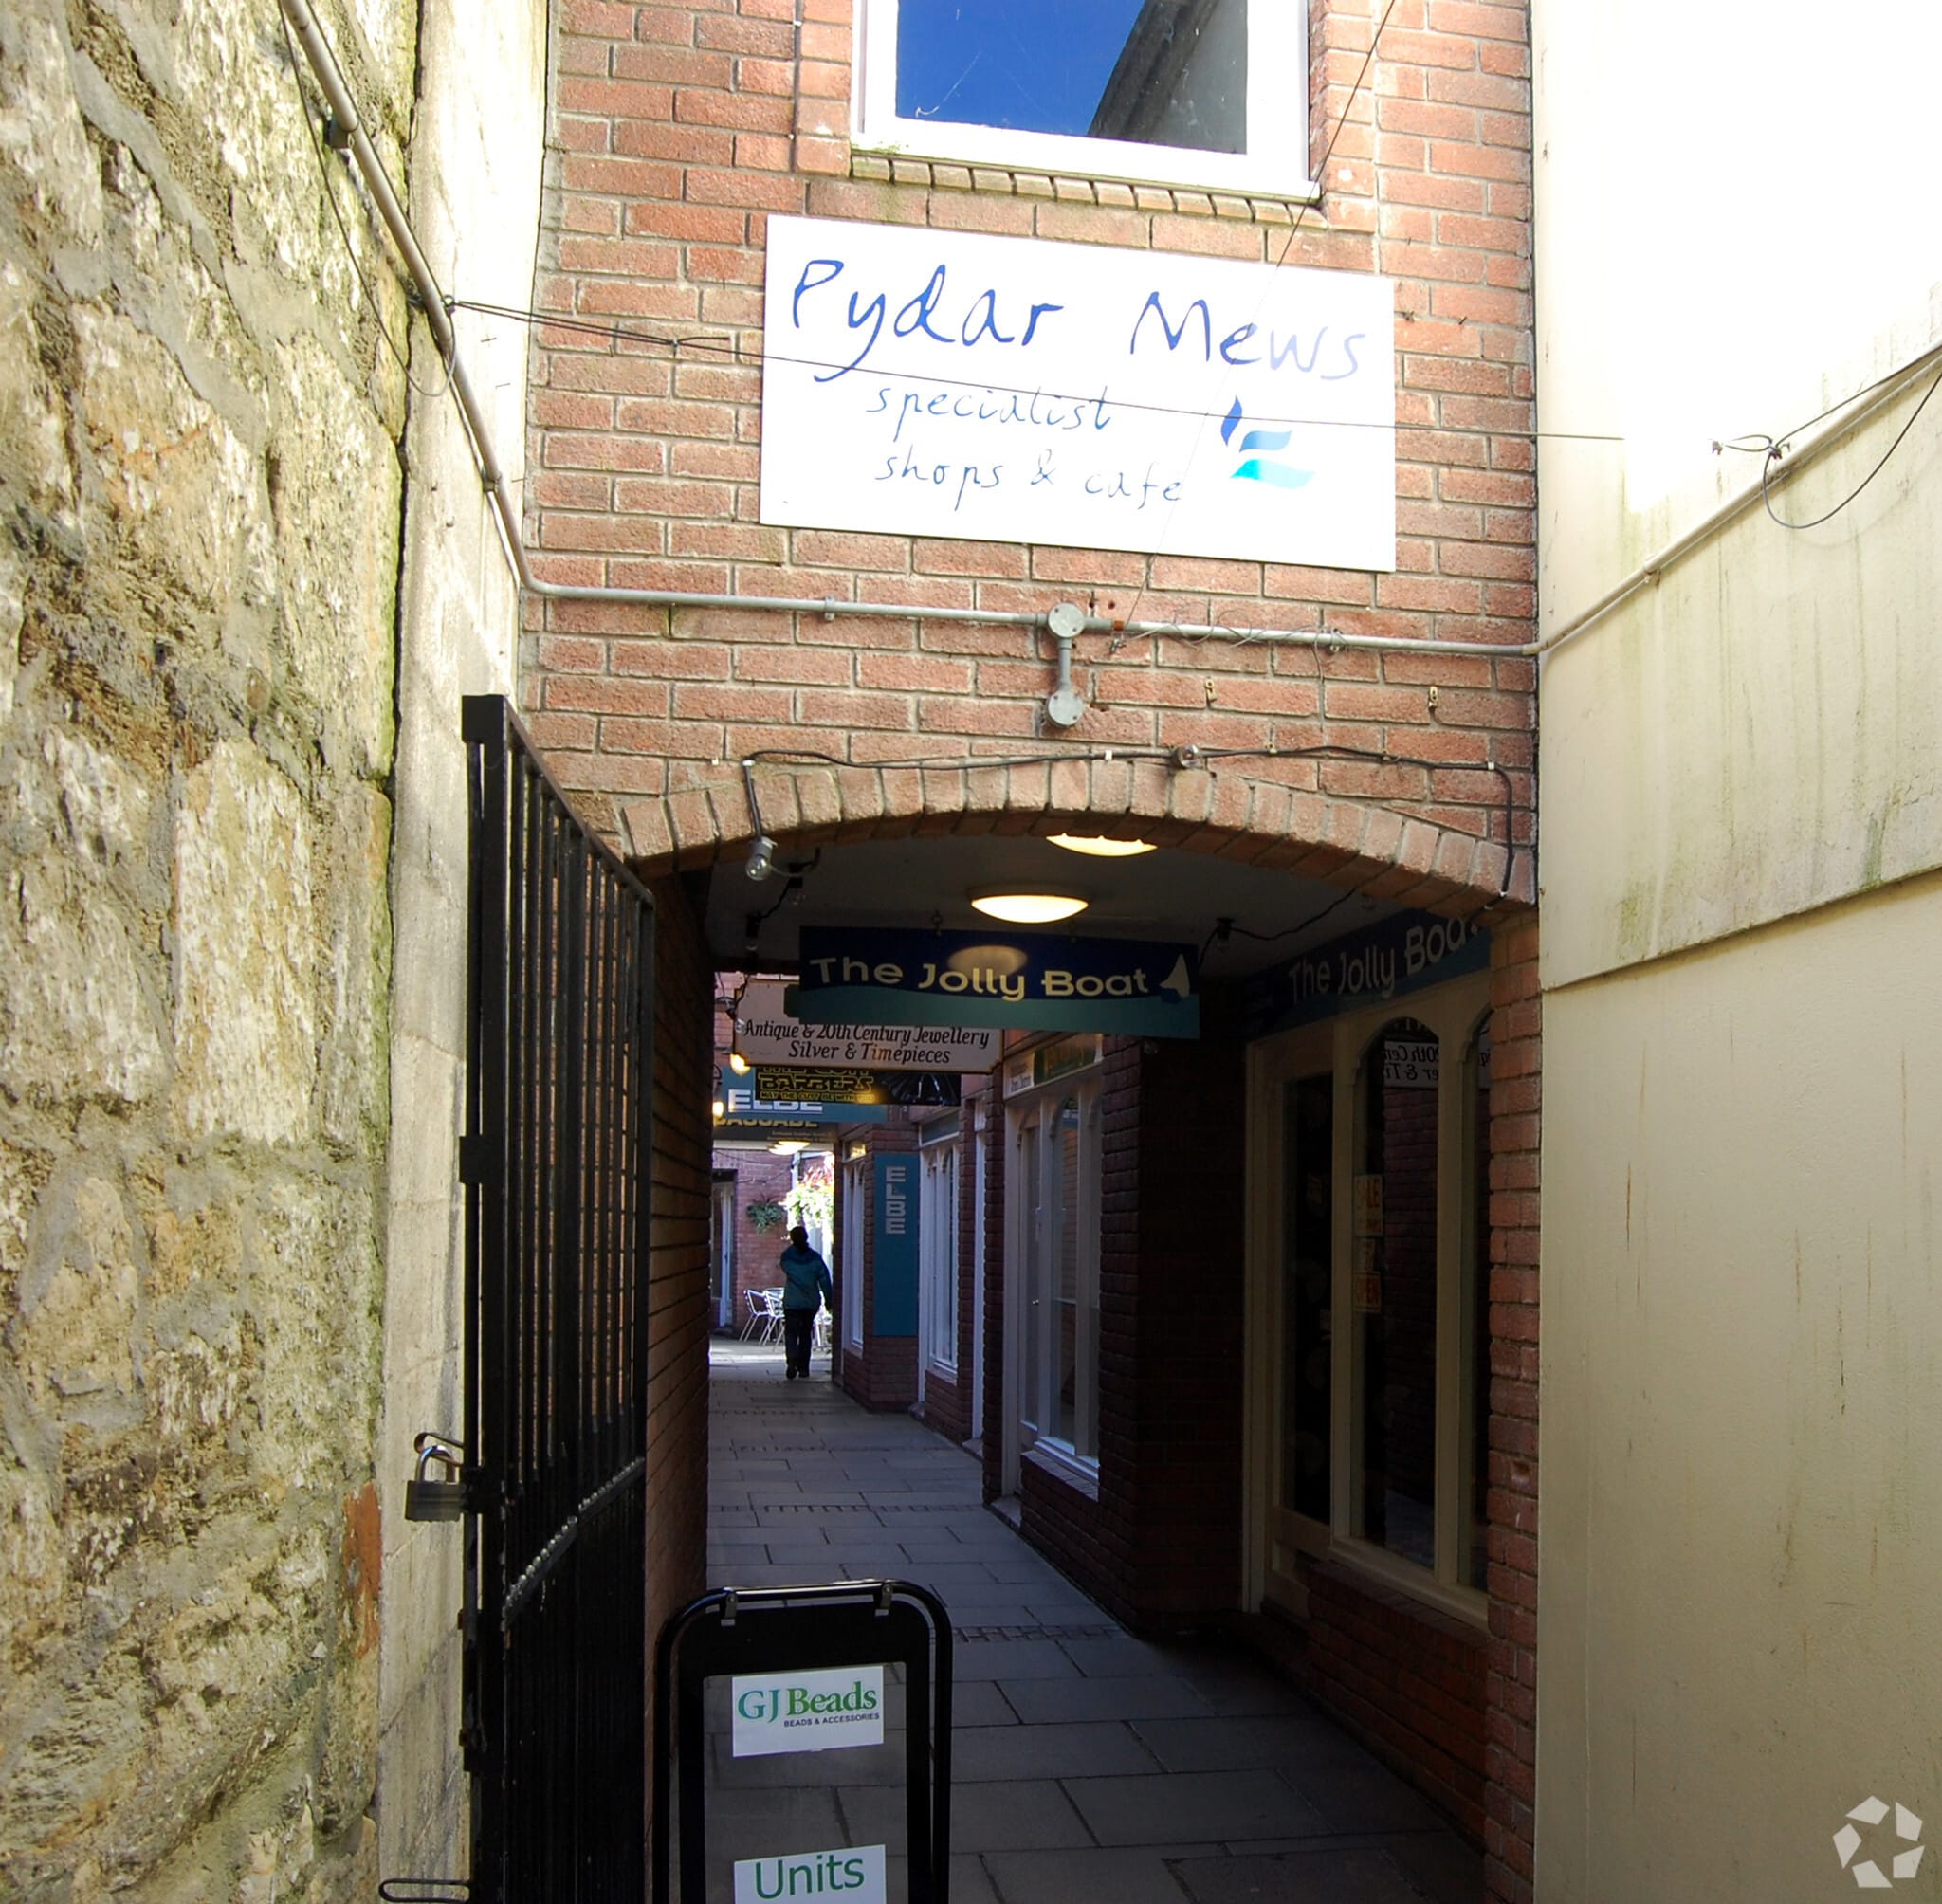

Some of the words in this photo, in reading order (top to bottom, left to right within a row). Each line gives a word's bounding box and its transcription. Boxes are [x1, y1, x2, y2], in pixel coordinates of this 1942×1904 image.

[793, 259, 1064, 382] Pydar
[1130, 290, 1366, 380] Mews
[866, 386, 1111, 443] specialist
[875, 444, 1004, 512] shops
[1030, 448, 1057, 486] &
[1084, 461, 1182, 510] cafe
[810, 956, 904, 984] The
[917, 962, 1026, 1002] Jolly
[1040, 968, 1149, 998] Boat
[1288, 954, 1332, 1006] The
[1336, 944, 1397, 998] Jolly
[1403, 916, 1478, 976] Boa
[744, 1018, 798, 1042] Antique
[816, 1024, 852, 1041] 20th
[853, 1025, 911, 1046] Century
[912, 1027, 990, 1050] Jewellery
[788, 1039, 839, 1060] Silver
[845, 1042, 857, 1060] &
[861, 1043, 951, 1065] Timepieces
[758, 1072, 874, 1094] BARBERS
[885, 1165, 907, 1235] ELBE
[737, 1688, 781, 1724] GJ
[785, 1680, 878, 1717] Beads
[783, 1717, 813, 1728] BEADS
[815, 1717, 820, 1726] &
[822, 1712, 881, 1726] ACCESSORIES
[755, 1854, 865, 1900] Units
